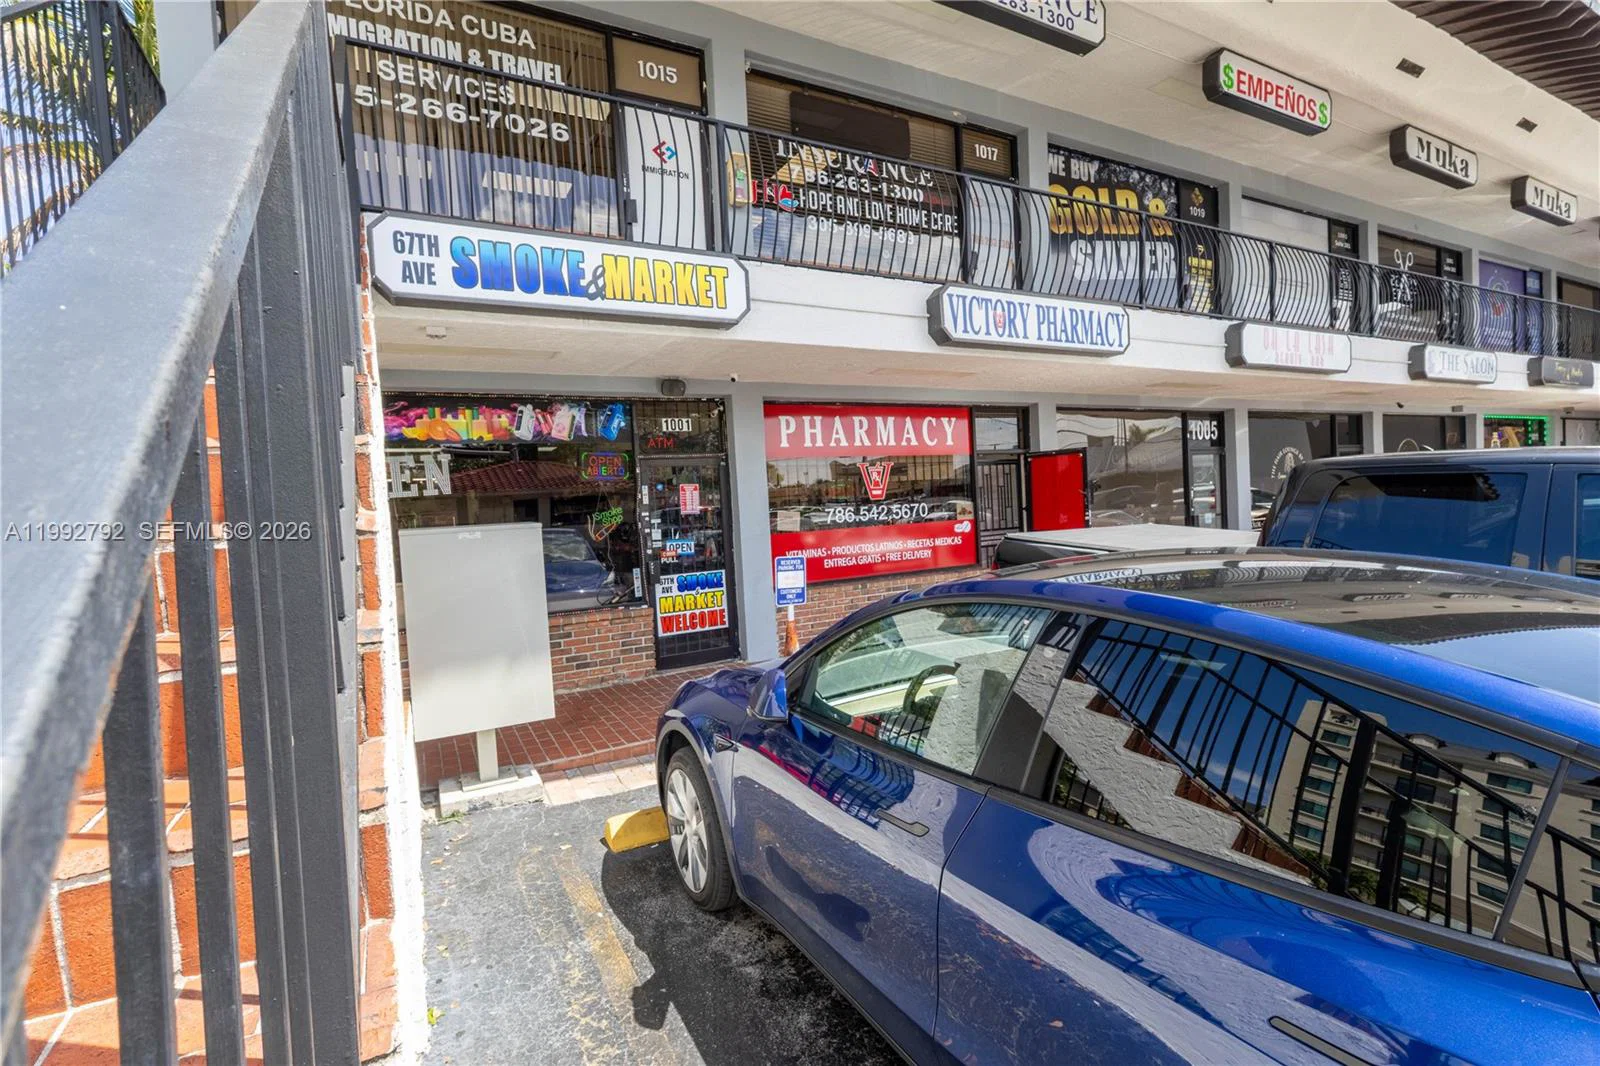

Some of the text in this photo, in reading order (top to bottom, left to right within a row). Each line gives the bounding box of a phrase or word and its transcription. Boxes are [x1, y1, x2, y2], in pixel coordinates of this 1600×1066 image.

[999, 0, 1075, 31] 63-1300
[461, 14, 536, 50] CUBA
[467, 48, 485, 68] &
[488, 49, 566, 86] TRAVEL
[637, 60, 678, 84] 1015
[378, 60, 516, 105] SERVICES
[974, 143, 998, 161] 1017
[1416, 135, 1469, 178] Muka
[1048, 153, 1100, 183] WE BUY
[800, 188, 833, 212] HOPE
[836, 195, 861, 217] AND
[865, 200, 893, 223] LOVE
[896, 205, 928, 229] HOME
[1049, 184, 1174, 237] GOLD &
[1188, 205, 1206, 218] 1019
[1532, 186, 1571, 219] Muka
[392, 229, 440, 258] 67TH
[401, 260, 437, 286] AVE
[449, 235, 730, 310] SMOKE & MARKET
[947, 292, 1125, 348] VICTORY PHARMACY
[1439, 351, 1494, 380] THE SALON
[663, 419, 691, 431] 1001
[778, 415, 957, 448] PHARMACY
[1191, 420, 1218, 440] 1005
[648, 437, 674, 448] ATM
[588, 455, 622, 466] OPEN
[594, 507, 624, 521] Smoke
[602, 514, 624, 526] Shop
[669, 542, 692, 553] OPEN
[785, 536, 962, 558] VITAMINAS PRODUCTOS LATINOS RECETAS MEDICAS
[824, 549, 933, 569] ENTREGA GRATIS FREE DELIVERY
[662, 585, 673, 594] AVE
[677, 571, 724, 592] SMOKE
[659, 589, 725, 614] MARKET
[660, 608, 727, 634] WELCOME
